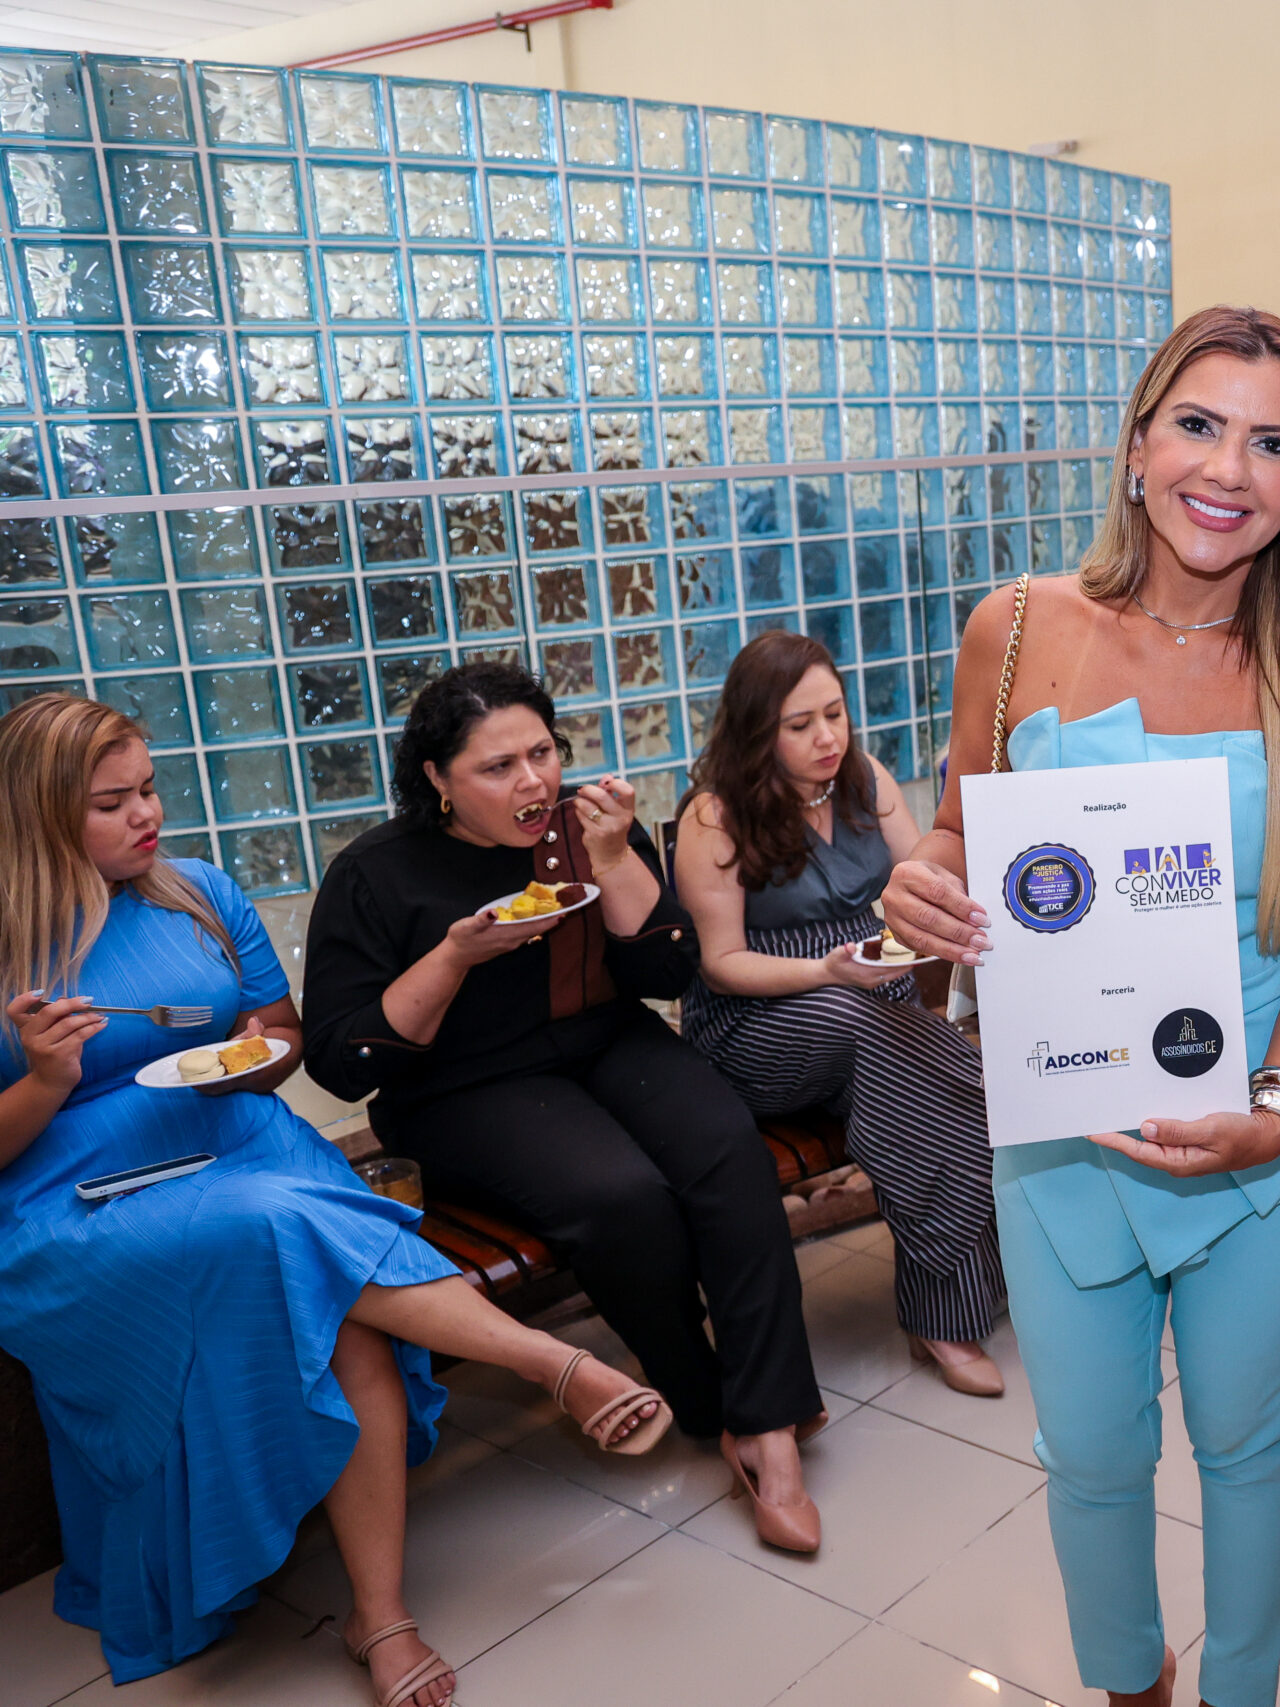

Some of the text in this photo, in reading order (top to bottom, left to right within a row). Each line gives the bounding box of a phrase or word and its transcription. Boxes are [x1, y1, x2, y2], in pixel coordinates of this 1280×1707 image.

[1083, 802, 1127, 812] Realização
[1032, 864, 1064, 872] PARCEIRO
[1037, 869, 1064, 877] JUSTIÇA
[1115, 868, 1222, 894] CONVIVER
[1130, 887, 1214, 907] SEM MEDO
[1101, 985, 1135, 996] Parceria
